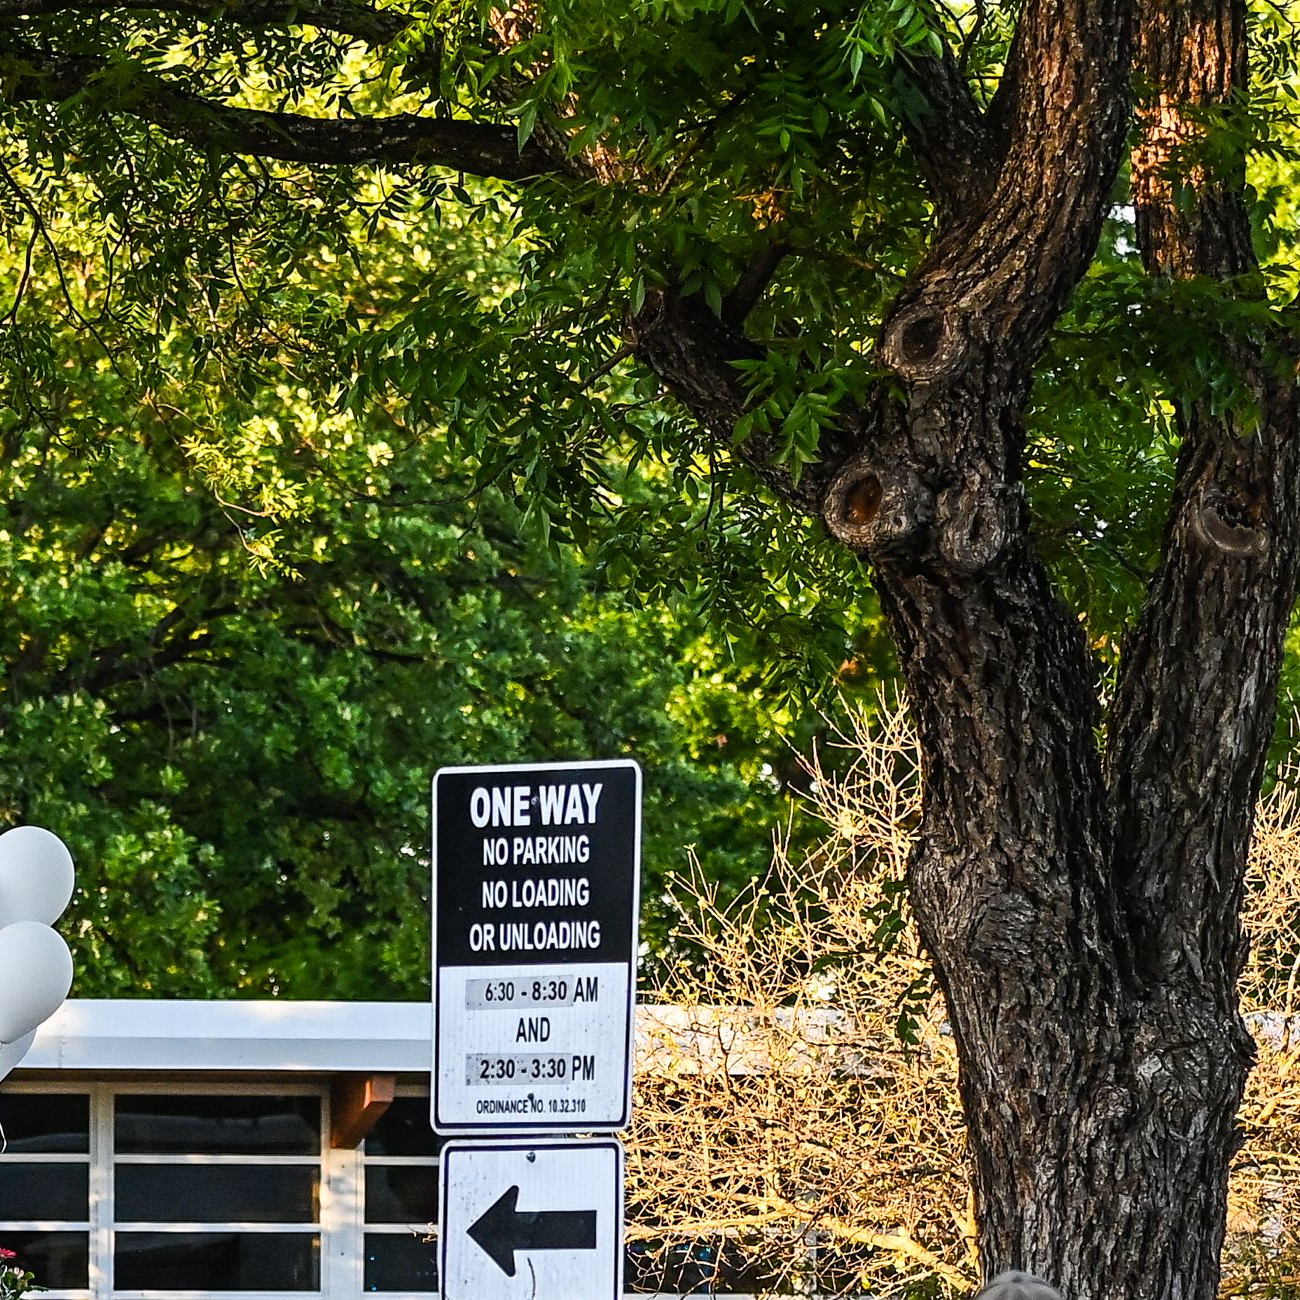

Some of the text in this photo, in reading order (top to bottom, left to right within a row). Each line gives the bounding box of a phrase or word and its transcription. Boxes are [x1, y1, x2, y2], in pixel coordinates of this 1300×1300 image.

[470, 783, 603, 828] ONE WAY
[483, 835, 590, 866] NO PARKING
[482, 878, 590, 909] NO LOADING
[469, 920, 601, 952] OR UNLOADING
[485, 981, 515, 1002] 6:30
[531, 980, 567, 1002] 8:30
[573, 976, 598, 1003] AM
[515, 1016, 551, 1043] AND
[479, 1059, 515, 1079] 2:30
[531, 1058, 566, 1079] 3:30
[571, 1055, 595, 1081] PM
[476, 1099, 529, 1114] ORDINANCE
[548, 1098, 586, 1113] 10.32.310
